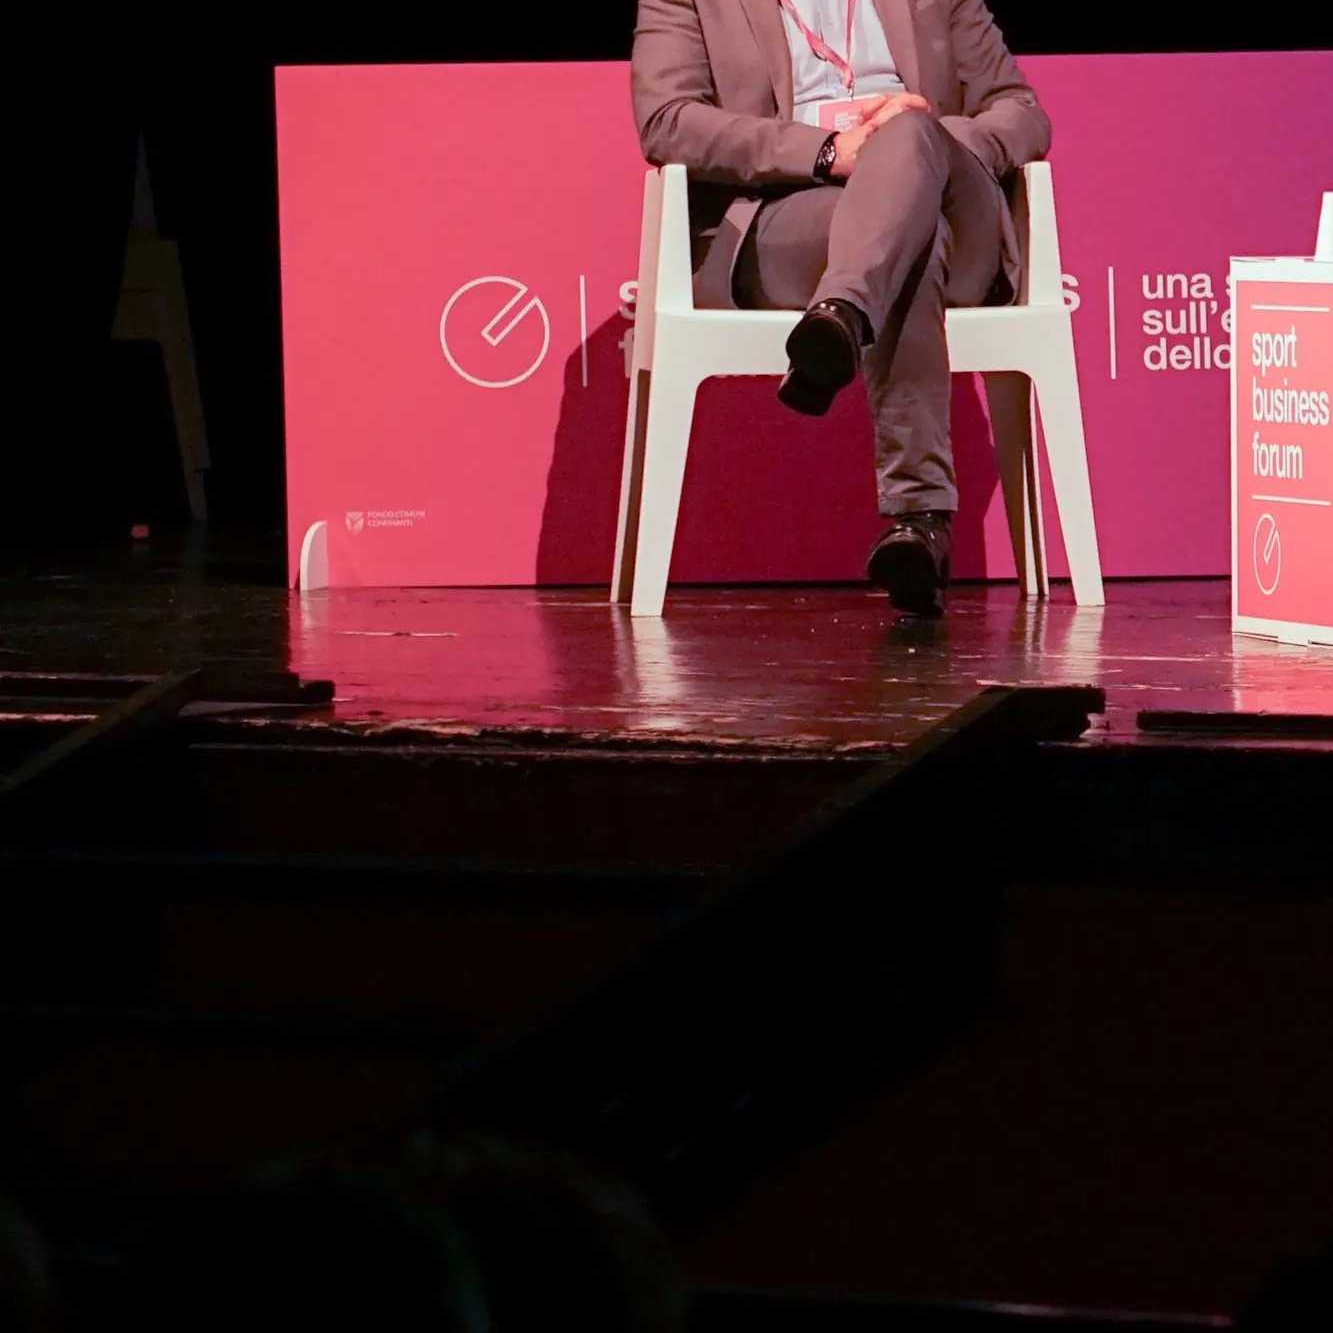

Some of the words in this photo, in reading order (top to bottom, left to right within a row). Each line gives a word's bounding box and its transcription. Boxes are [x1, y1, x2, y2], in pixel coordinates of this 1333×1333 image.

[1142, 273, 1213, 300] una
[1252, 325, 1297, 377] sport
[1252, 377, 1330, 427] business
[1252, 432, 1303, 480] forum
